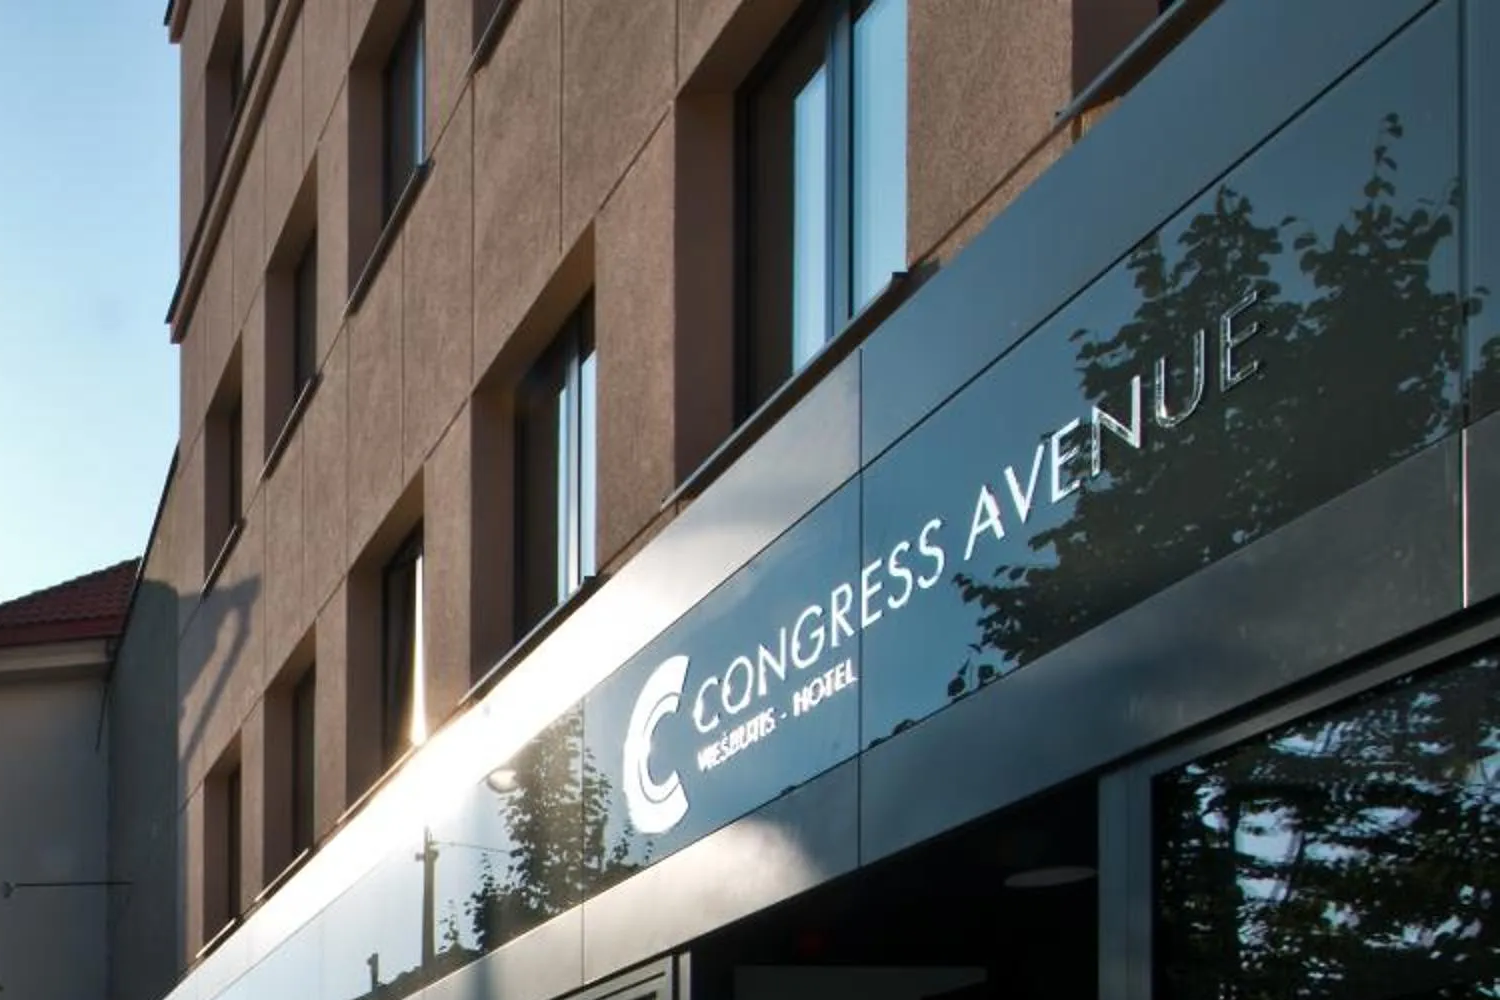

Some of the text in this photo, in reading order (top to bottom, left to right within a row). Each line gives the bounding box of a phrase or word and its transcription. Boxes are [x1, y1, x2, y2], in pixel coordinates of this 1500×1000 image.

[692, 290, 1259, 733] CONGRESS AVENUE
[792, 657, 859, 717] HOTEL
